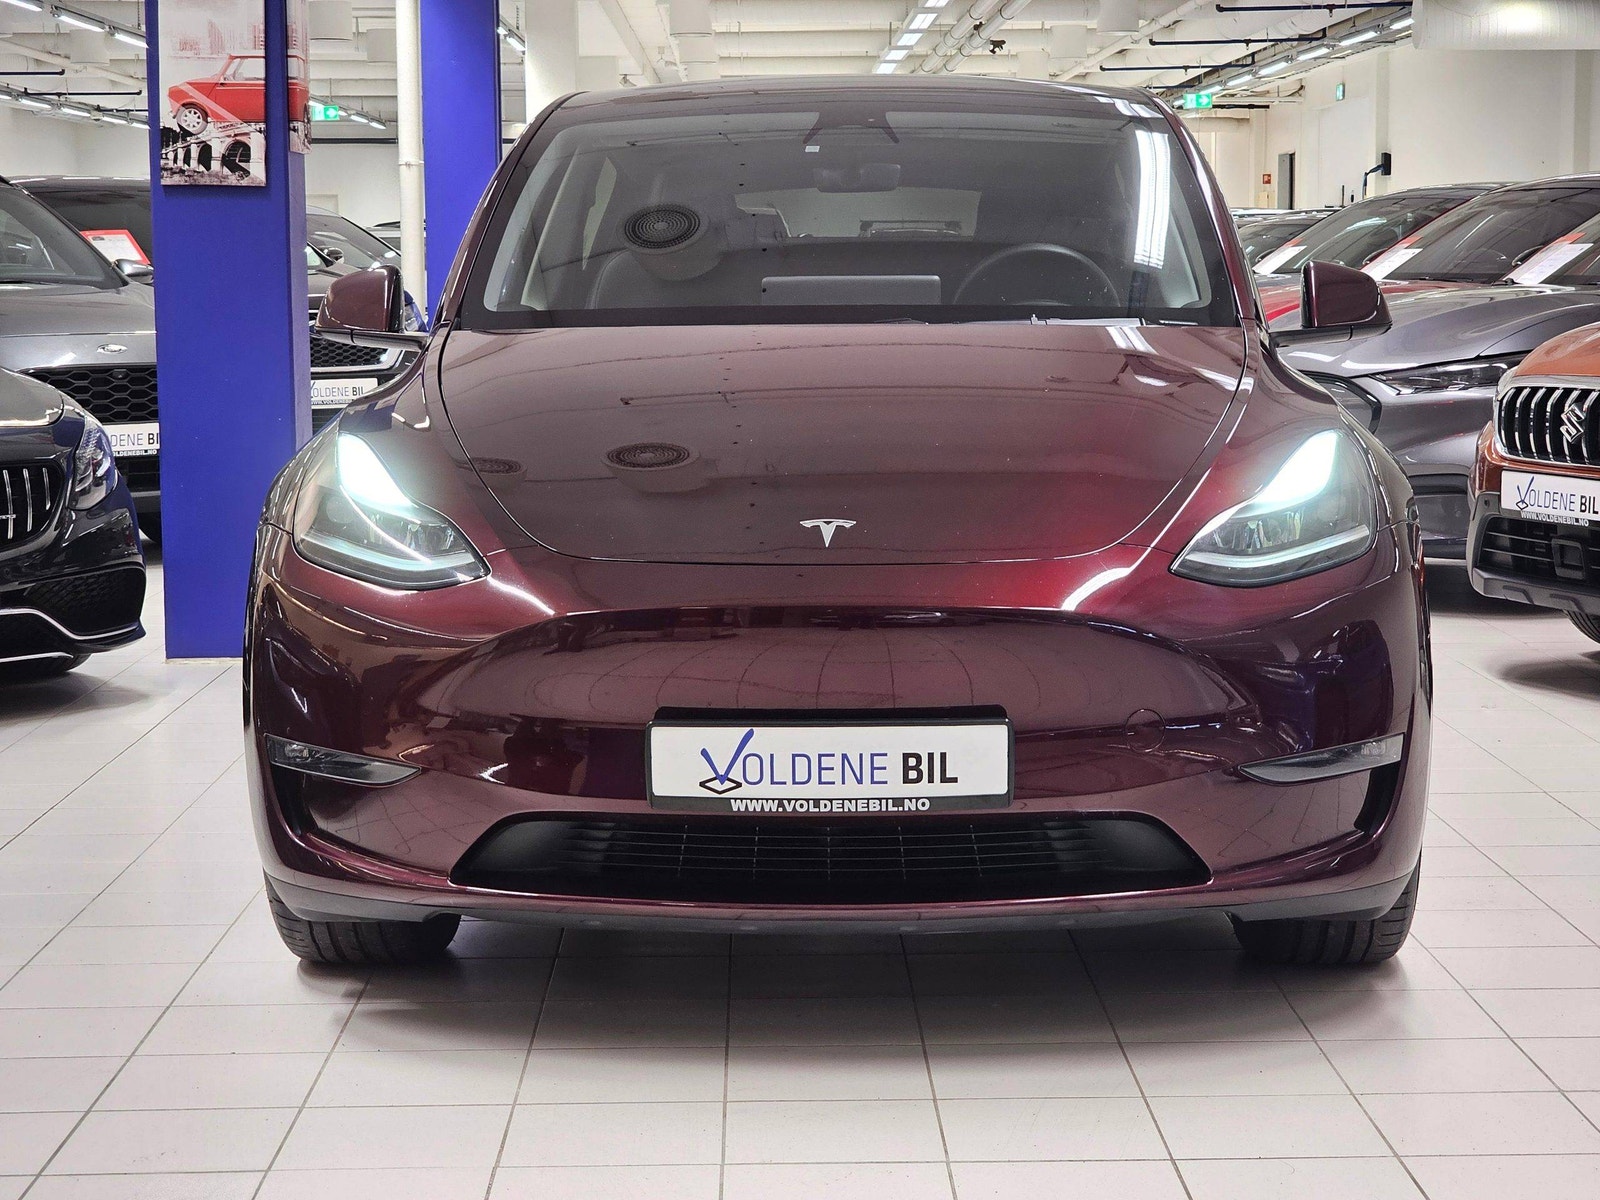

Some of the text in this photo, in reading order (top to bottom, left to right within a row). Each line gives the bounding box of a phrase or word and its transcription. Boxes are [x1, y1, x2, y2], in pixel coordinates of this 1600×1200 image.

[110, 433, 159, 447] DENE BI
[1516, 475, 1599, 515] VOLDENE BIL
[1521, 510, 1590, 527] WWW.VOLDENEBIL.NO
[700, 728, 959, 786] VOLDENE BIL
[730, 798, 931, 813] WWW.VOLDENEBIL.NO
